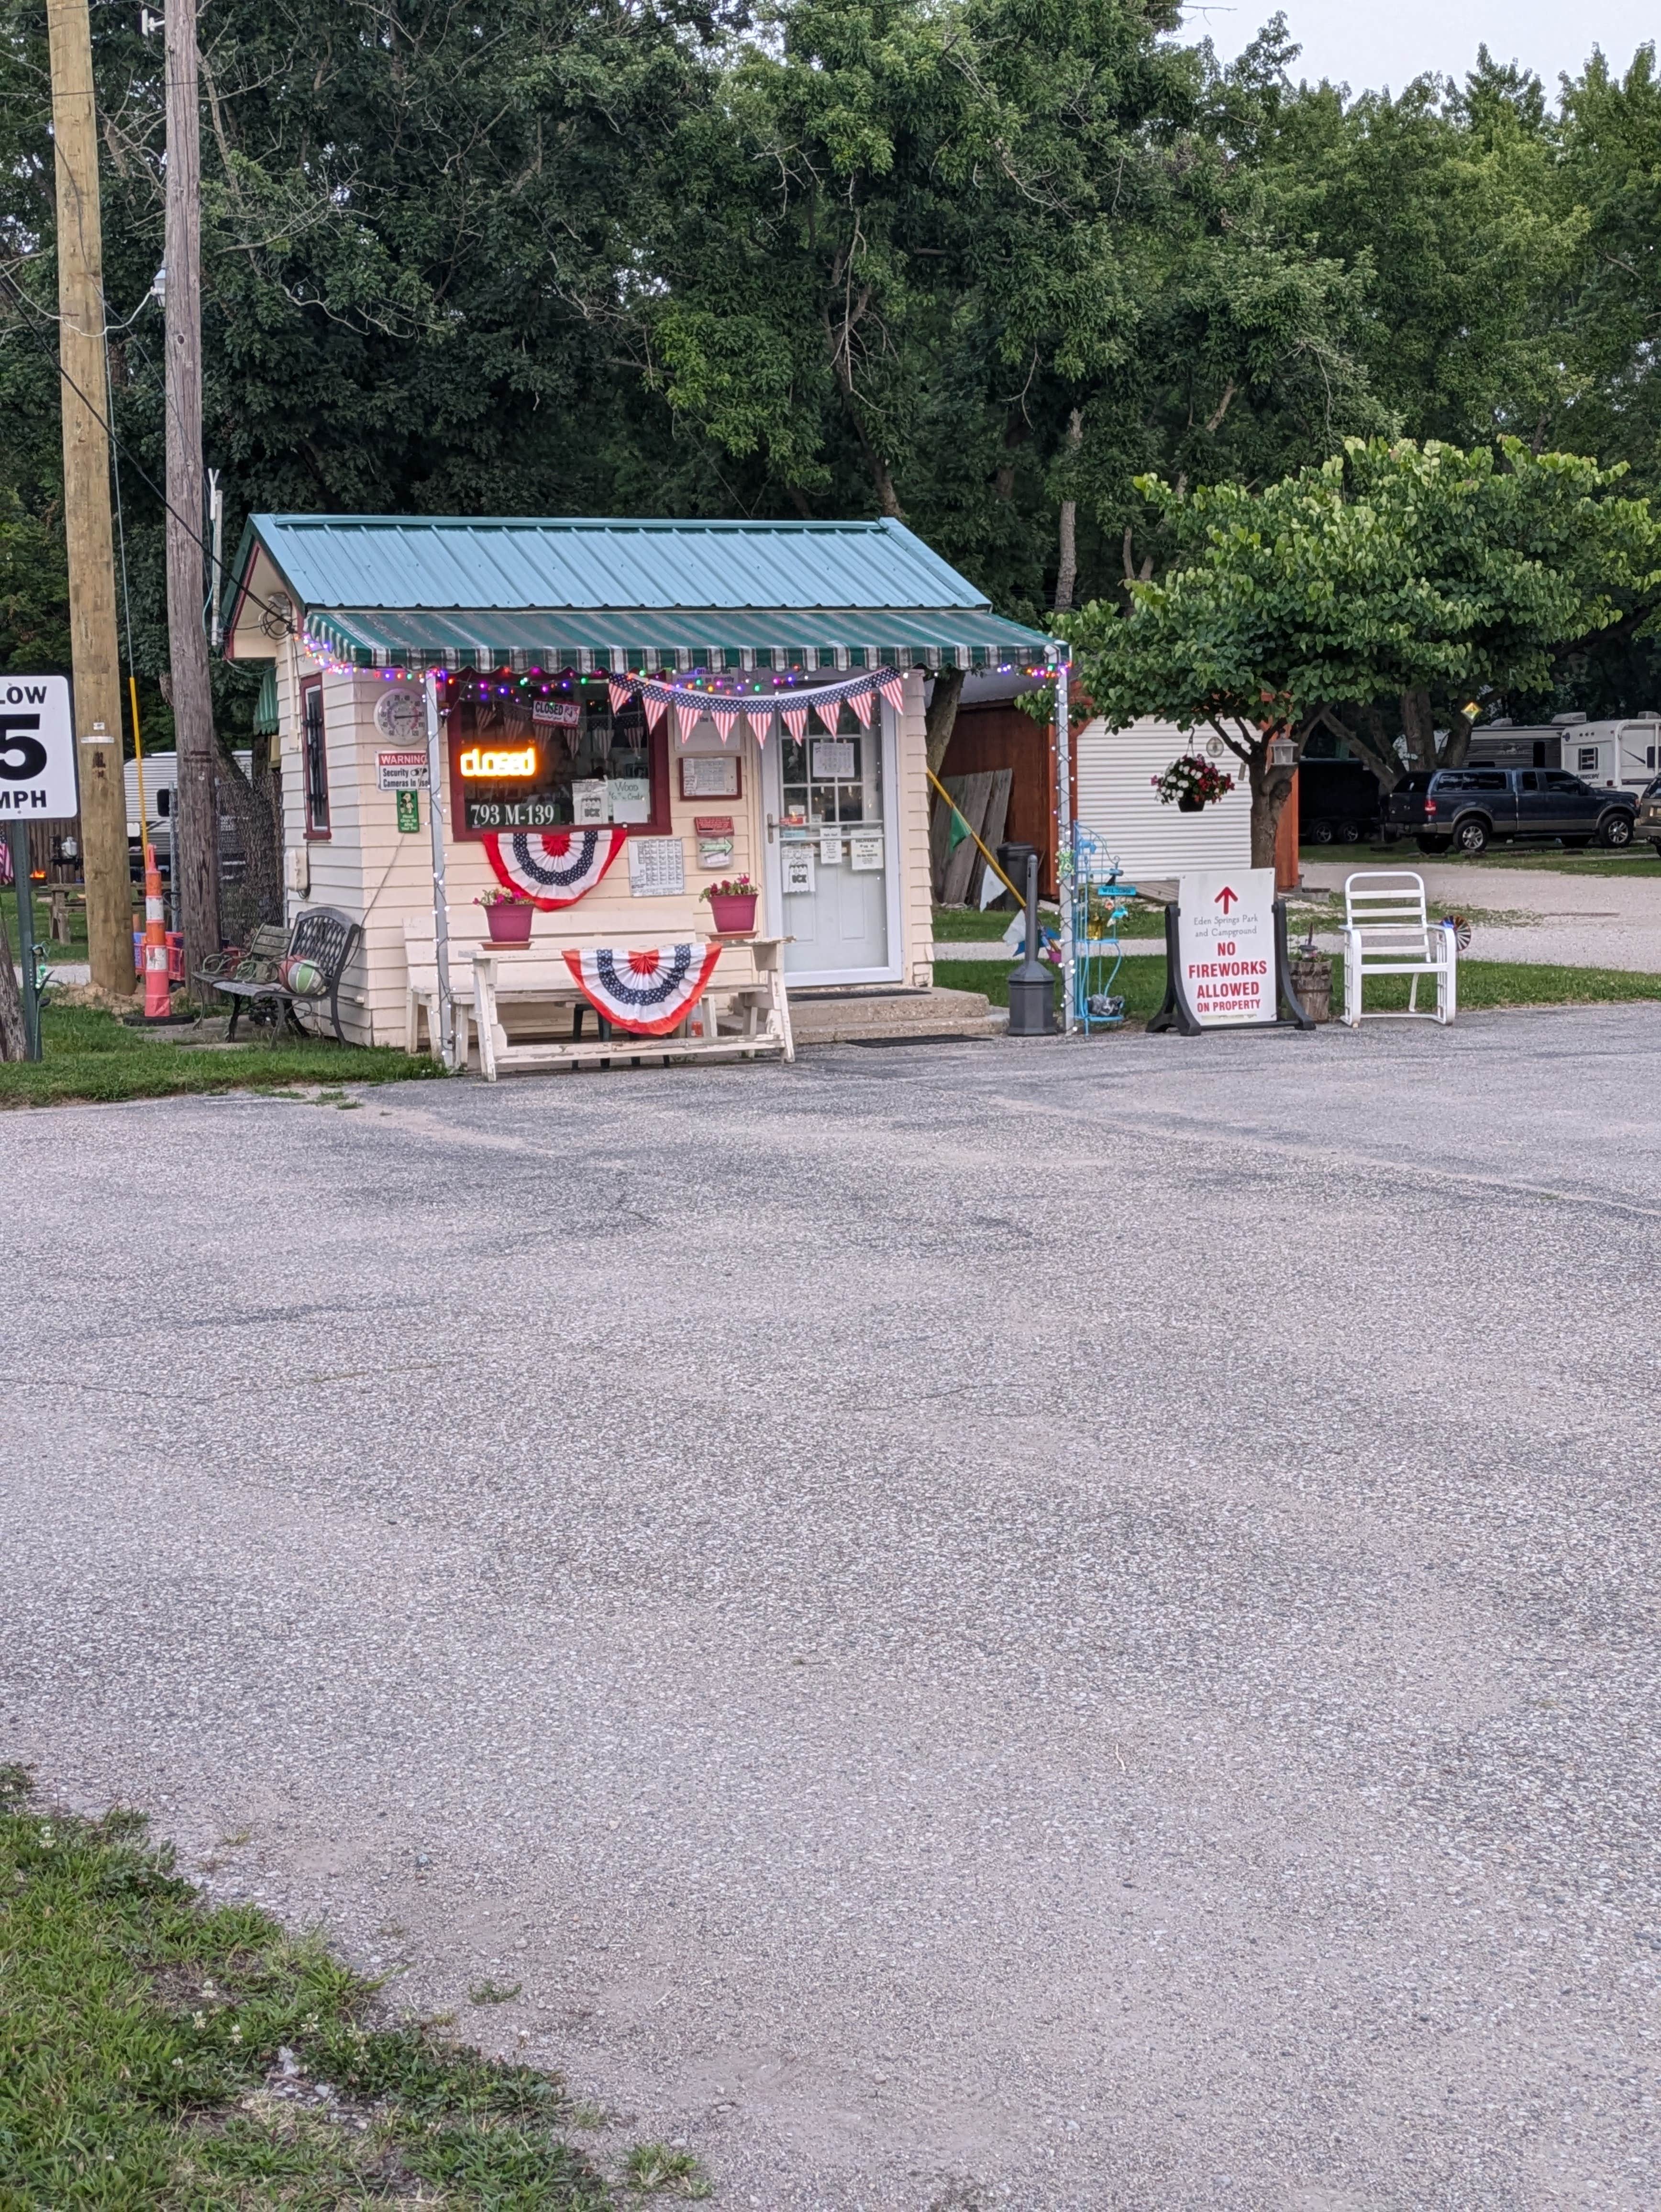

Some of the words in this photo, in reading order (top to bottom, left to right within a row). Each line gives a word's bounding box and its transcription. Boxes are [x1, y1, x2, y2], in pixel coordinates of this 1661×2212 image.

[535, 701, 563, 716] CLOSED
[0, 714, 47, 781] 5
[460, 747, 535, 776] closed
[383, 768, 408, 778] Security
[383, 778, 408, 787] Cameras
[0, 790, 47, 808] MPH
[470, 804, 500, 825] 793
[504, 804, 554, 826] M-139
[1194, 917, 1212, 925] Eden
[1214, 916, 1240, 927] Springs
[1242, 914, 1258, 923] Park
[1195, 929, 1208, 938] and
[1211, 926, 1257, 938] Campground
[1217, 941, 1236, 957] NO
[1188, 960, 1267, 979] FIREWORKS
[1196, 981, 1260, 999] ALLOWED
[1196, 1002, 1210, 1013] ON
[1213, 999, 1261, 1012] PROPERTY
